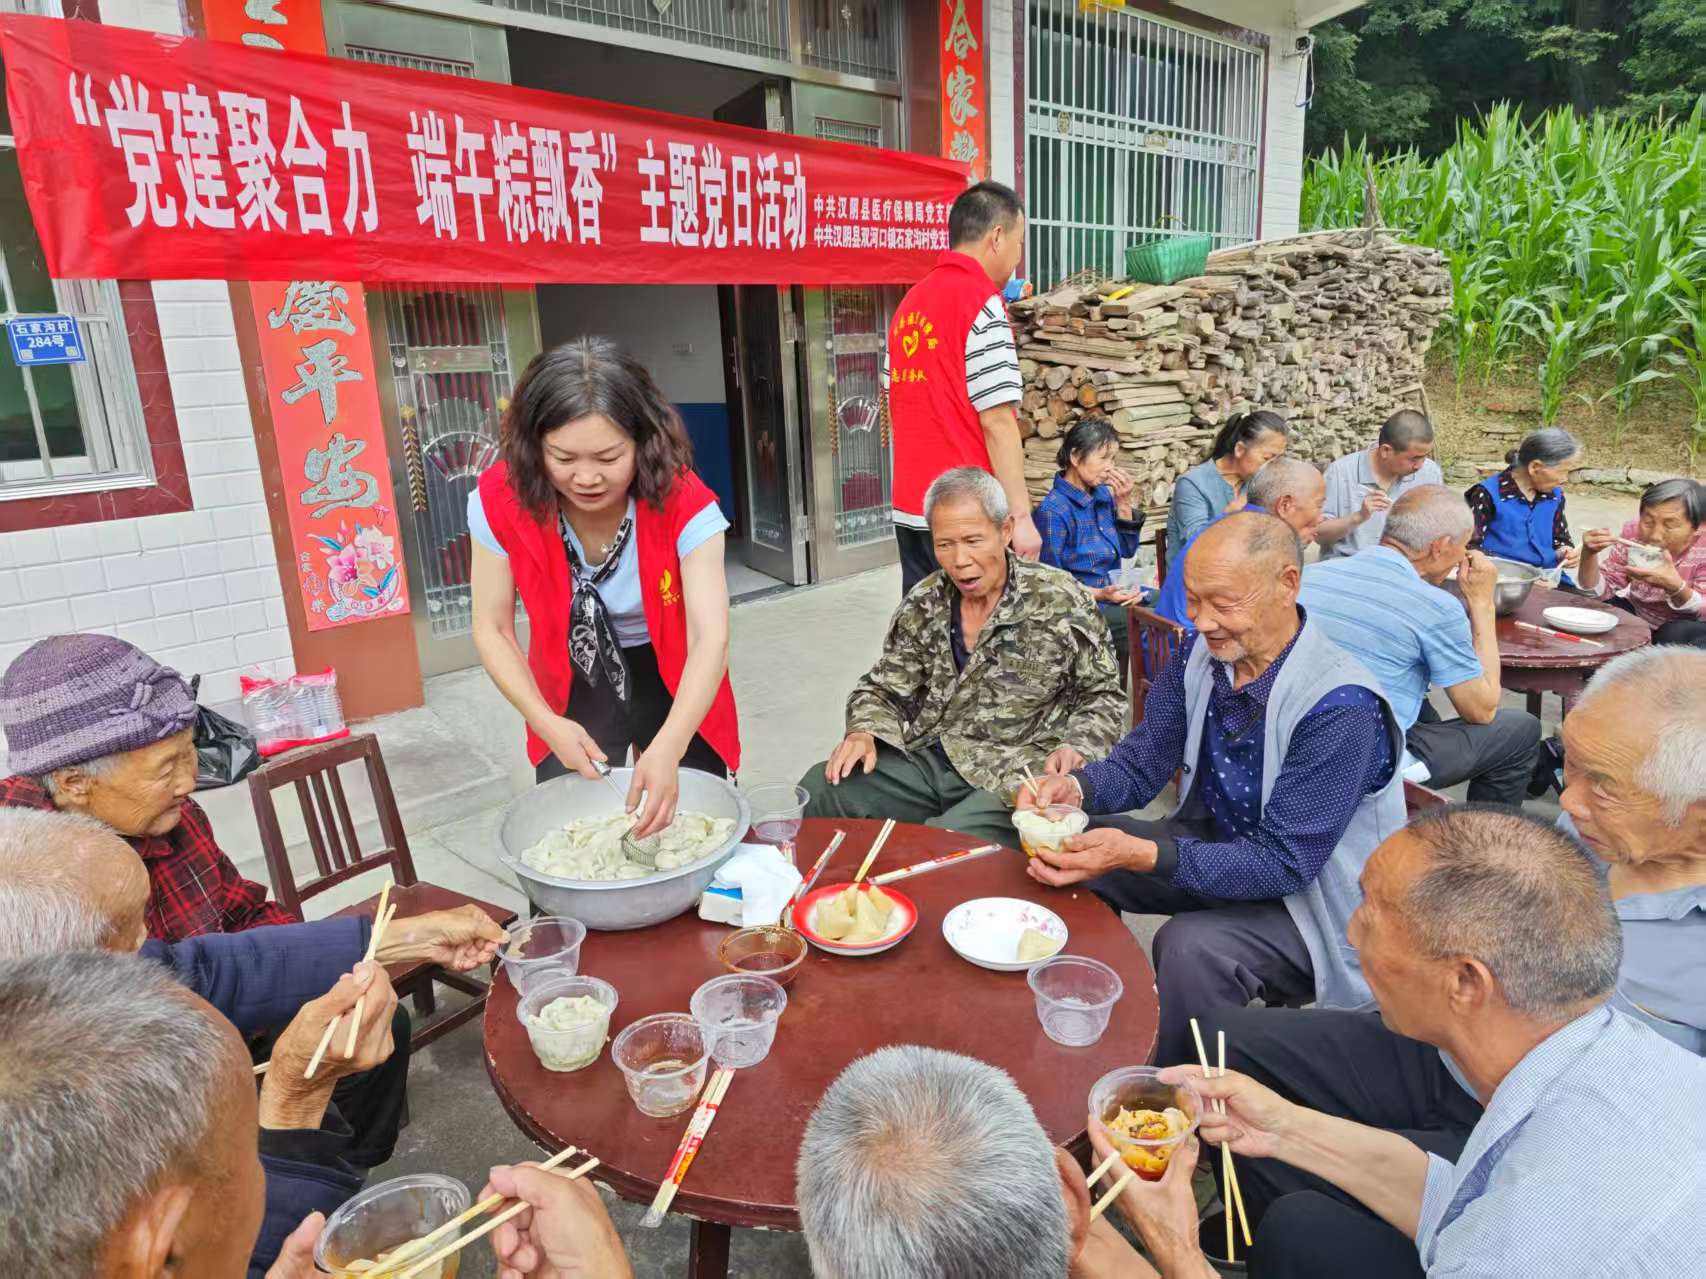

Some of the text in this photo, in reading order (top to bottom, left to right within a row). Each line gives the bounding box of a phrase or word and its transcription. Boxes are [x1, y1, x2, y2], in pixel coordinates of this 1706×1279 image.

[69, 71, 379, 235] “党建聚合力
[637, 138, 807, 251] 主题党日活动
[813, 193, 953, 225] 中共汉阴县医疗保障局党支
[813, 223, 951, 250] 中共汉阴县双河口镇石家沟村党支
[27, 334, 65, 349] 284号
